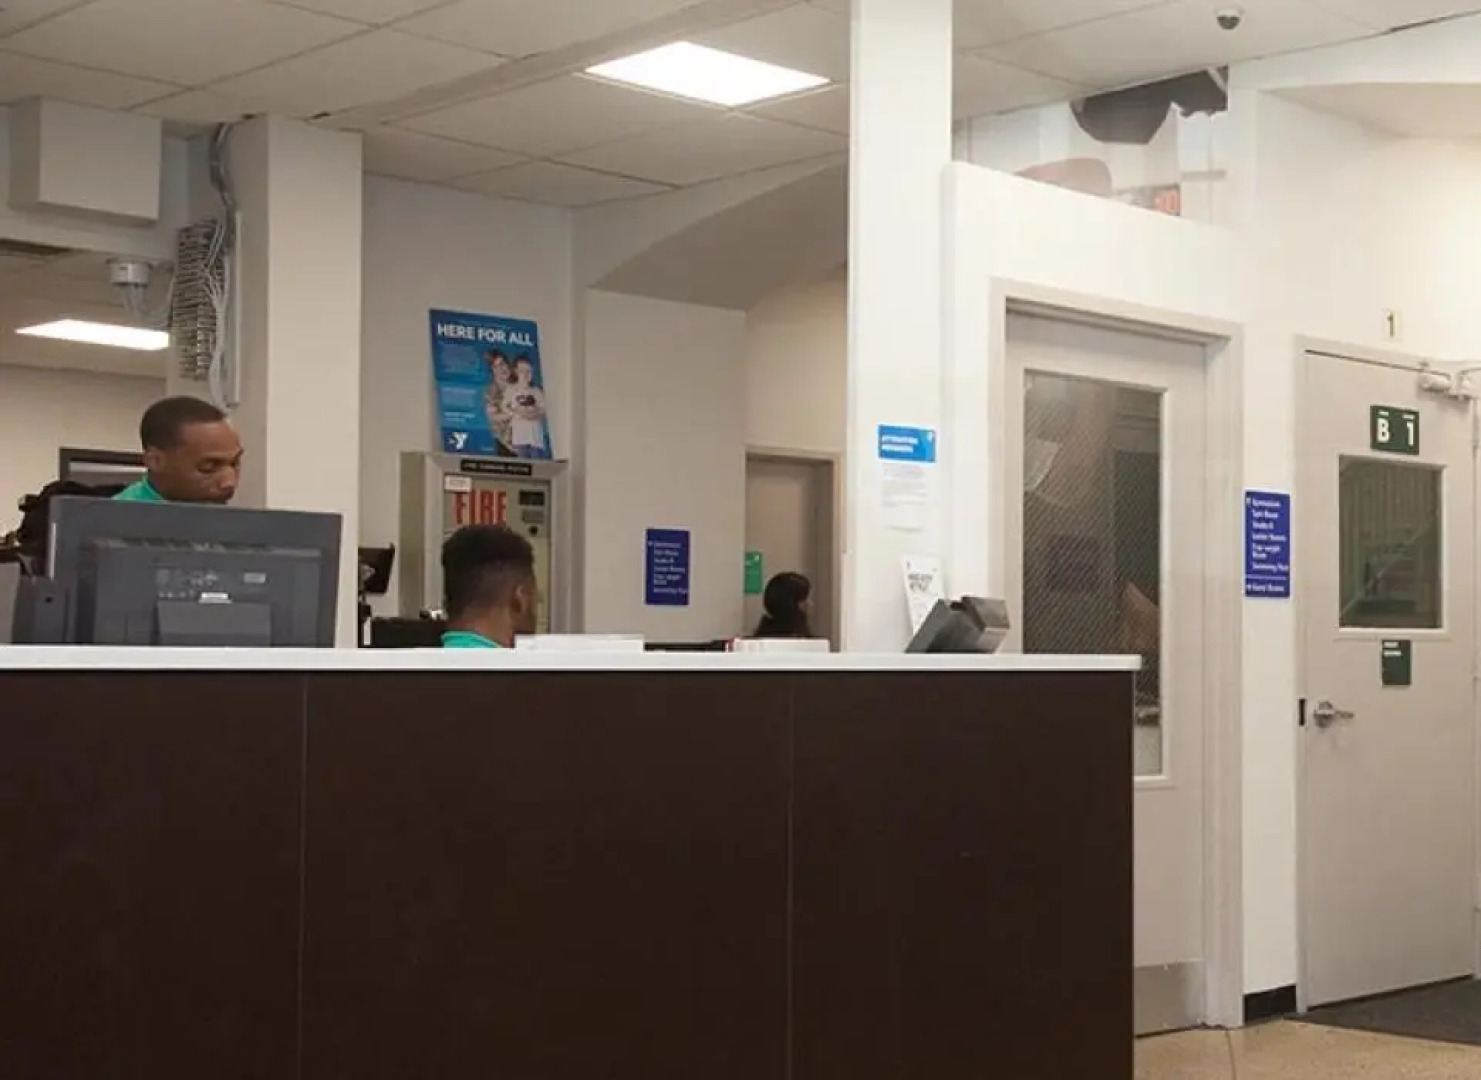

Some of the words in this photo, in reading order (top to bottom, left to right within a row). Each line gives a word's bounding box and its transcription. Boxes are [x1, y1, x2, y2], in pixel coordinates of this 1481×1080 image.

[437, 323, 475, 340] HERE
[478, 328, 506, 343] FOR
[508, 332, 533, 346] ALL
[1387, 313, 1394, 337] 1
[1376, 418, 1390, 443] B
[1406, 421, 1414, 446] 1
[455, 489, 506, 525] FIRE
